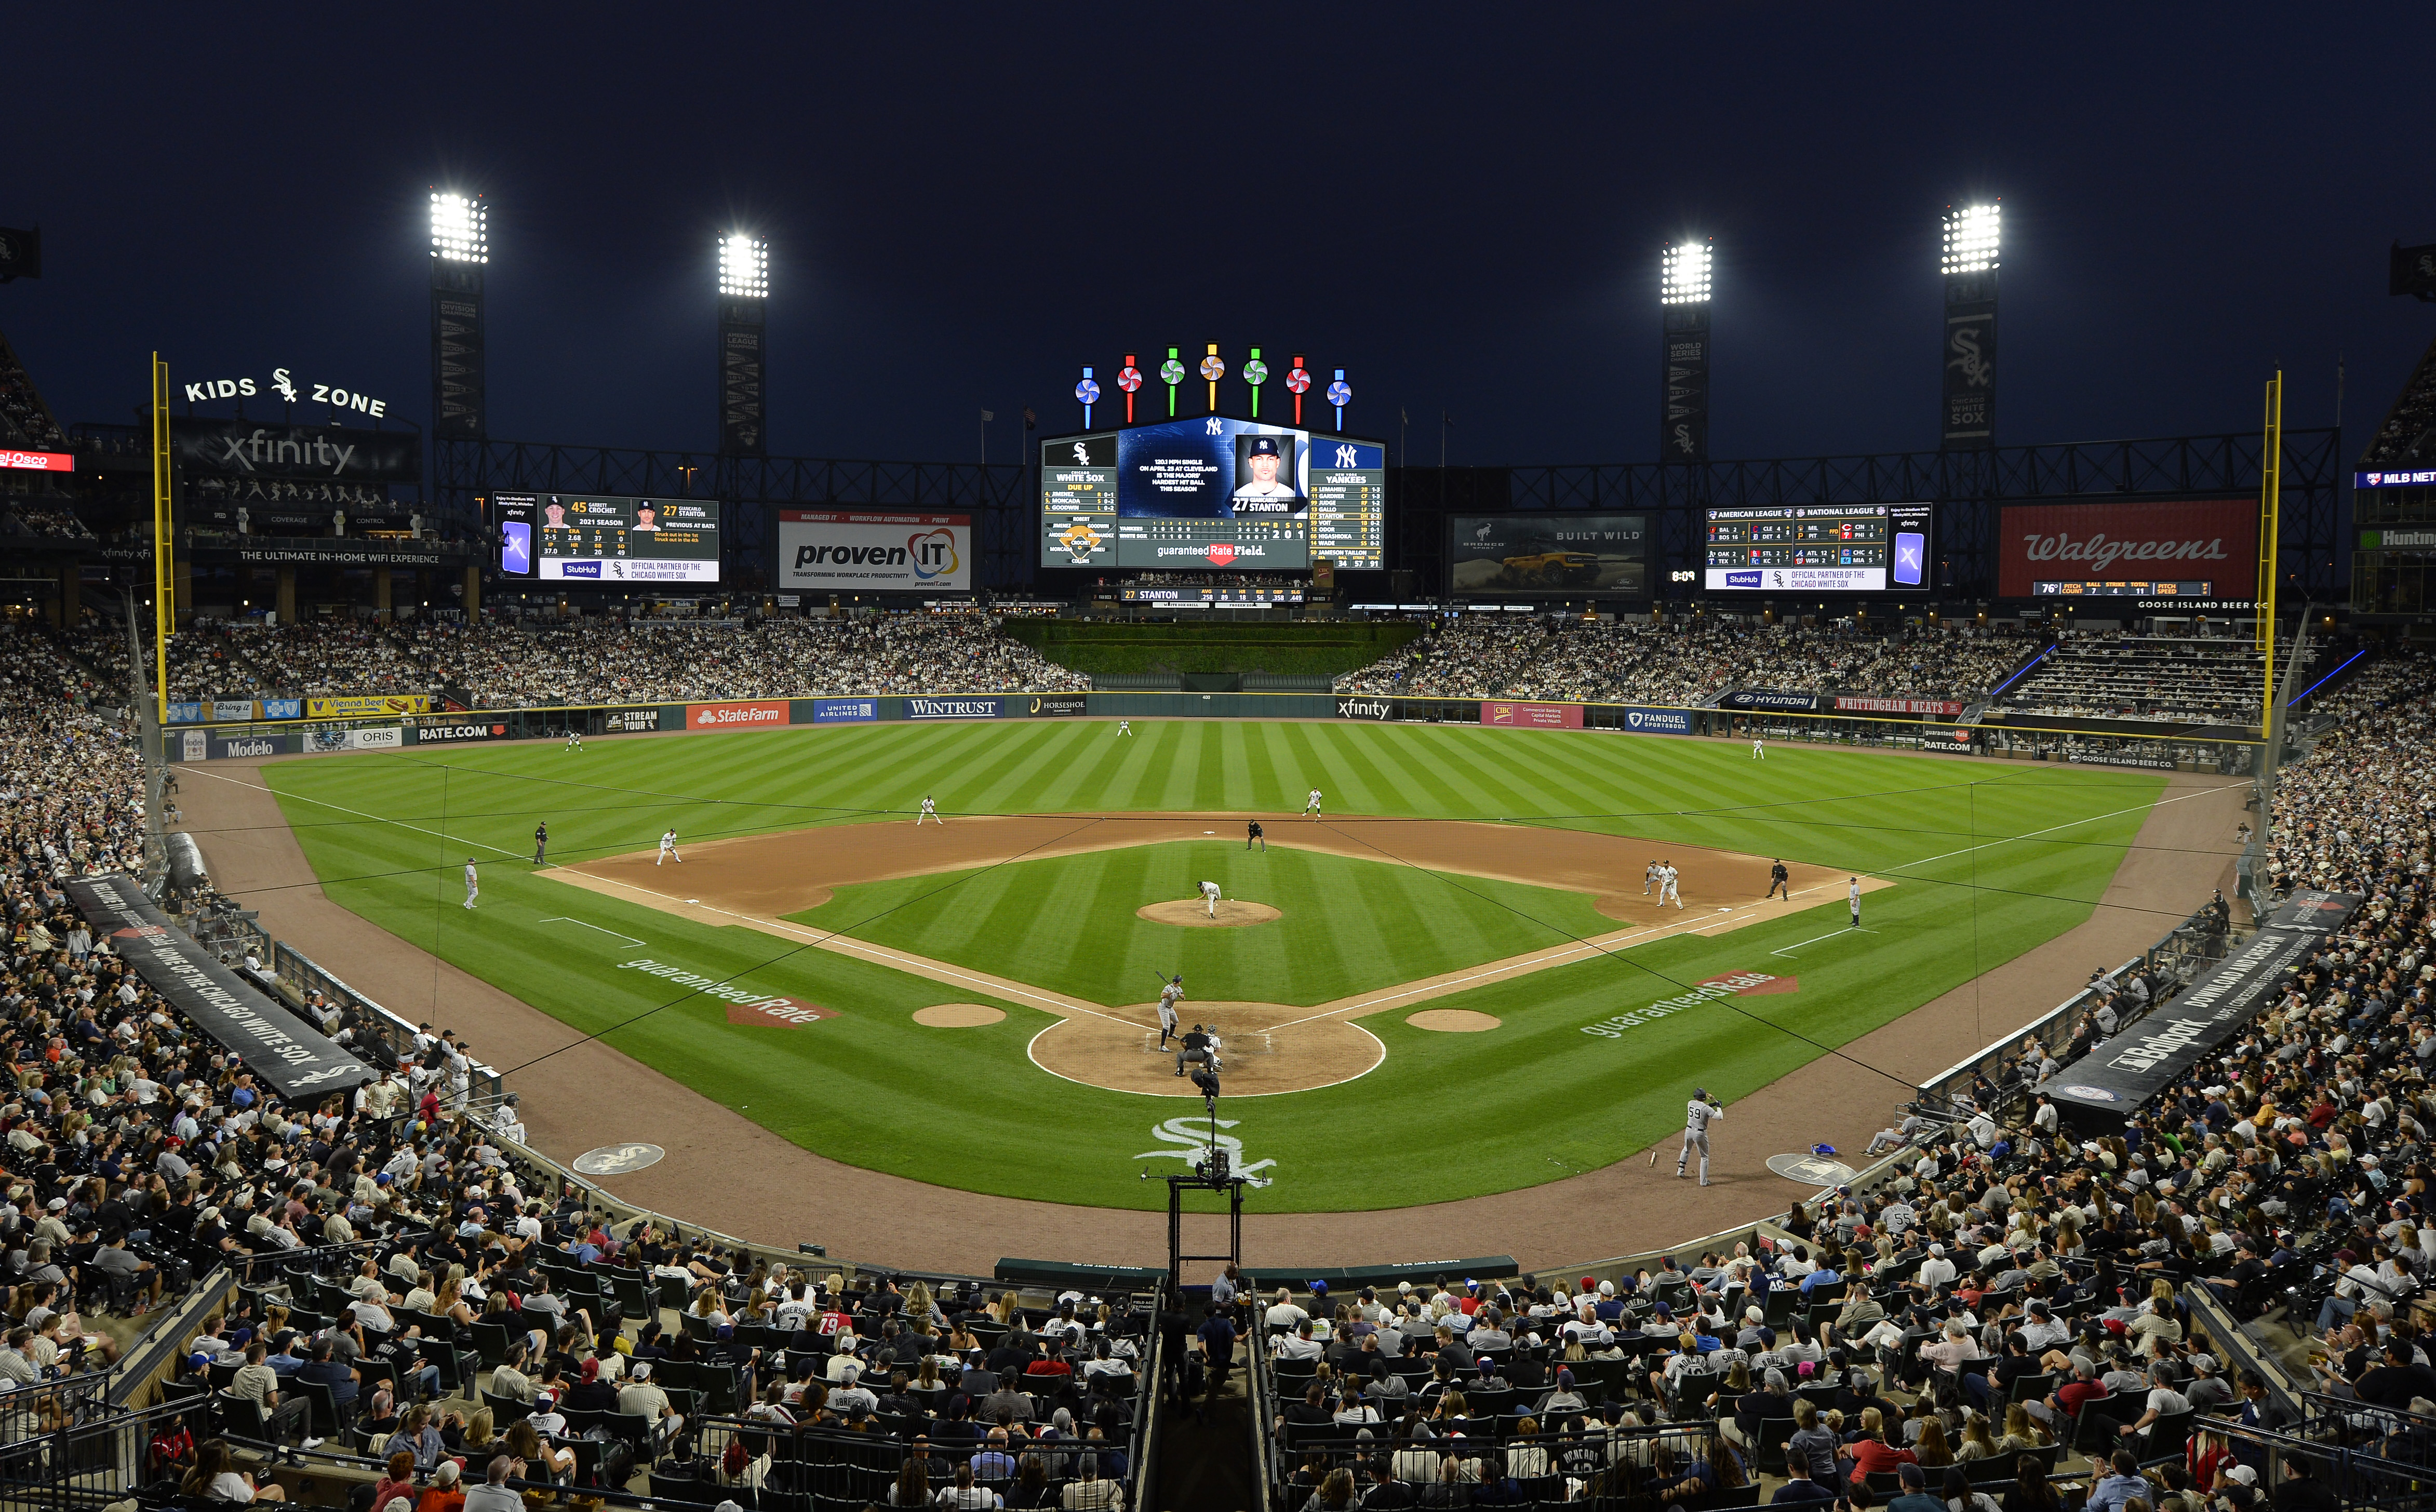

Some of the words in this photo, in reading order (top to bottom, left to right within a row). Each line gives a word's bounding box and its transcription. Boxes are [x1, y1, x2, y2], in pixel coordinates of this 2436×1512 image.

[441, 303, 476, 313] DIVISION
[185, 378, 257, 402] KIDS
[312, 384, 386, 418] ZONE
[1951, 412, 1984, 424] SOX
[223, 429, 355, 475] xfinity
[2384, 473, 2410, 484] MLB
[2413, 472, 2436, 482] NET
[572, 502, 586, 513] 45
[663, 505, 677, 516] 27
[1233, 498, 1248, 511] 27
[1250, 503, 1288, 512] STANTON
[1557, 532, 1598, 541] BUILT
[1604, 531, 1640, 540] WILD
[101, 550, 133, 558] xfinity
[240, 551, 262, 559] THE
[264, 551, 316, 560] ULTIMATE
[319, 553, 365, 561] IN-HOME
[368, 554, 388, 562] WIFI
[391, 554, 439, 563] EXPERIENCE
[795, 545, 906, 569] proven
[922, 543, 945, 565] IT
[1158, 546, 1209, 557] guaranteed
[1211, 546, 1232, 555] Rate
[1234, 546, 1266, 556] Field.
[2024, 533, 2228, 572] Walgreens
[567, 565, 596, 573] StubHub
[1672, 571, 1695, 581] 8:09
[1125, 591, 1134, 599] 27
[1140, 591, 1178, 599] STANTON
[329, 699, 363, 707] Vienna
[365, 698, 385, 706] Beef
[1755, 696, 1810, 705] HYUNDAI
[1838, 698, 1907, 712] WHITTINGHAM
[1910, 700, 1943, 713] MEATS
[216, 702, 236, 713] Bring
[911, 700, 996, 714] WINTRUST
[1339, 700, 1390, 720] xfinity
[624, 711, 657, 721] STREAM
[1644, 715, 1685, 723] FANDUEL
[624, 721, 645, 730] YOUR
[363, 731, 393, 741] ORIS
[420, 726, 487, 740] RATE.COM
[228, 741, 273, 757] Modelo
[1924, 741, 1970, 751] RATE.COM
[2110, 757, 2137, 765] ISLAND
[2243, 935, 2286, 960] CHECK-IN
[151, 947, 189, 966] HOME
[170, 965, 199, 974] OF
[2228, 959, 2259, 973] AND
[181, 973, 216, 988] THE
[617, 959, 773, 1003] guaranteed
[747, 998, 820, 1023] Rate
[2184, 971, 2245, 1008] DOWNLOAD
[196, 987, 256, 1019] CHICAGO
[1580, 987, 1729, 1038] guaranteed
[1703, 973, 1775, 992] Rate
[2212, 1008, 2237, 1021] MAPS
[238, 1018, 293, 1046] WHITE
[2124, 1018, 2213, 1061] Ballpark.
[274, 1045, 320, 1065] SOX
[1689, 1107, 1701, 1119] 59
[1894, 1213, 1911, 1225] 55
[789, 1317, 798, 1330] 7
[819, 1318, 838, 1334] 79
[1722, 1352, 1747, 1363] SHIELDS
